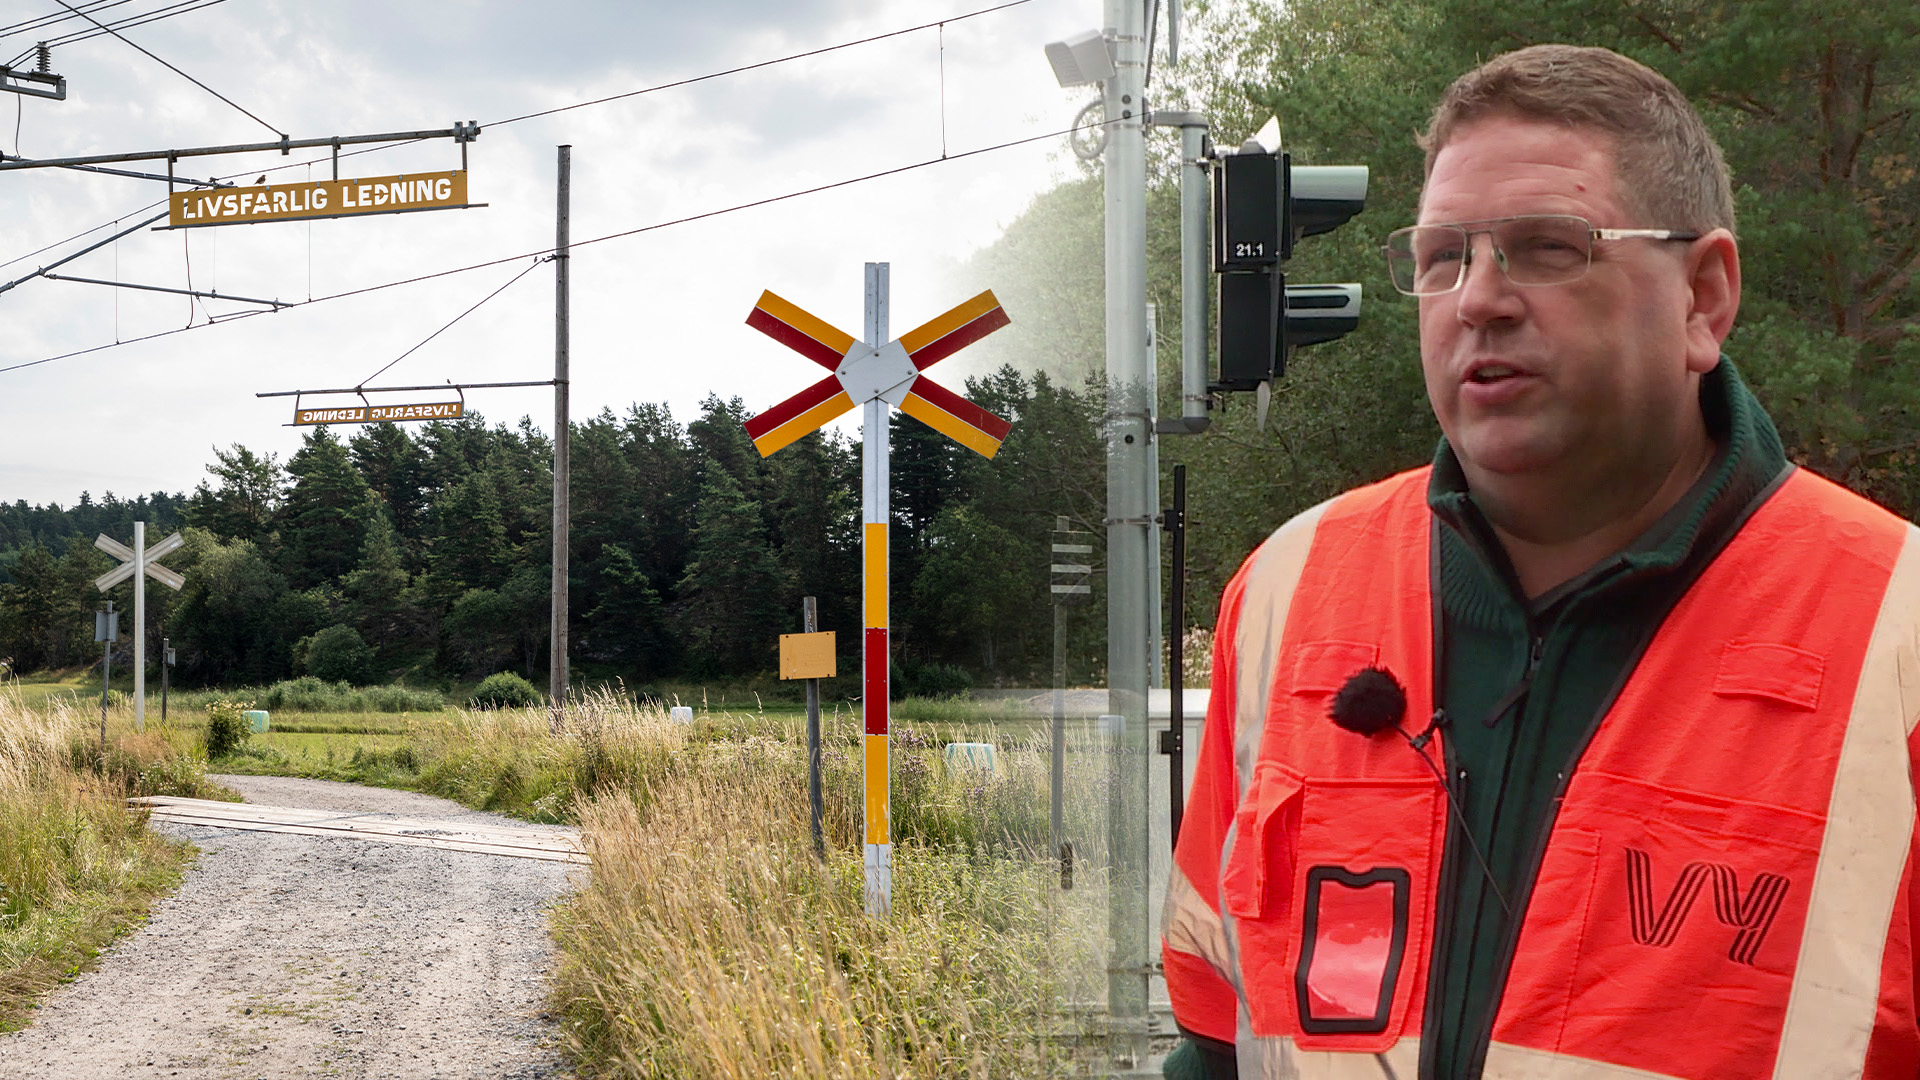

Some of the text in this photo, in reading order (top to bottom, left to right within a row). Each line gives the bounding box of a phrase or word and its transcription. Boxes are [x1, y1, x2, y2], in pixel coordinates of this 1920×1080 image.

[183, 179, 451, 218] LIVSFARLIG LEDNING
[1236, 243, 1263, 257] 21.1
